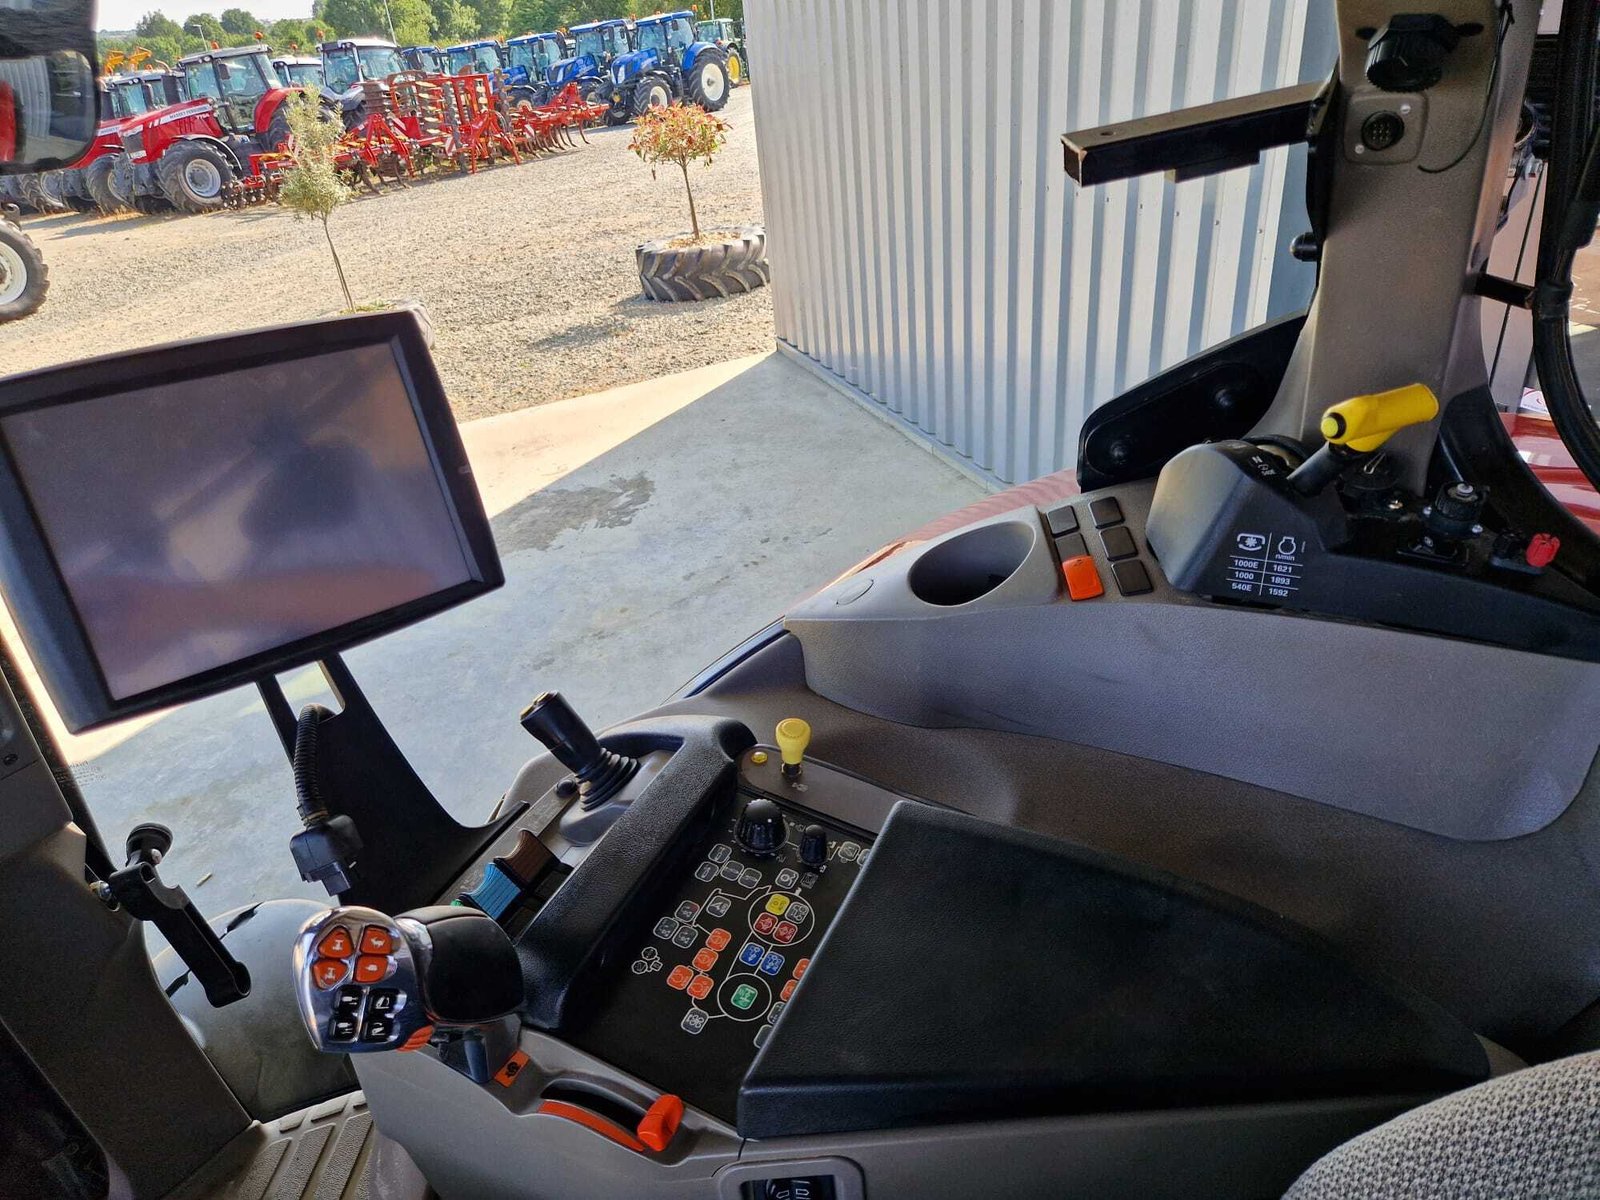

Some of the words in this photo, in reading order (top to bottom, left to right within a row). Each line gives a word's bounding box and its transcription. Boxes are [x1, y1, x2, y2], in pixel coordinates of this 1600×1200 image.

[1234, 560, 1259, 569] 1000E
[1273, 564, 1292, 573] 1621
[1234, 571, 1254, 580] 1000
[1271, 576, 1291, 585] 1893
[1231, 582, 1253, 592] 540E
[1268, 588, 1289, 597] 1592
